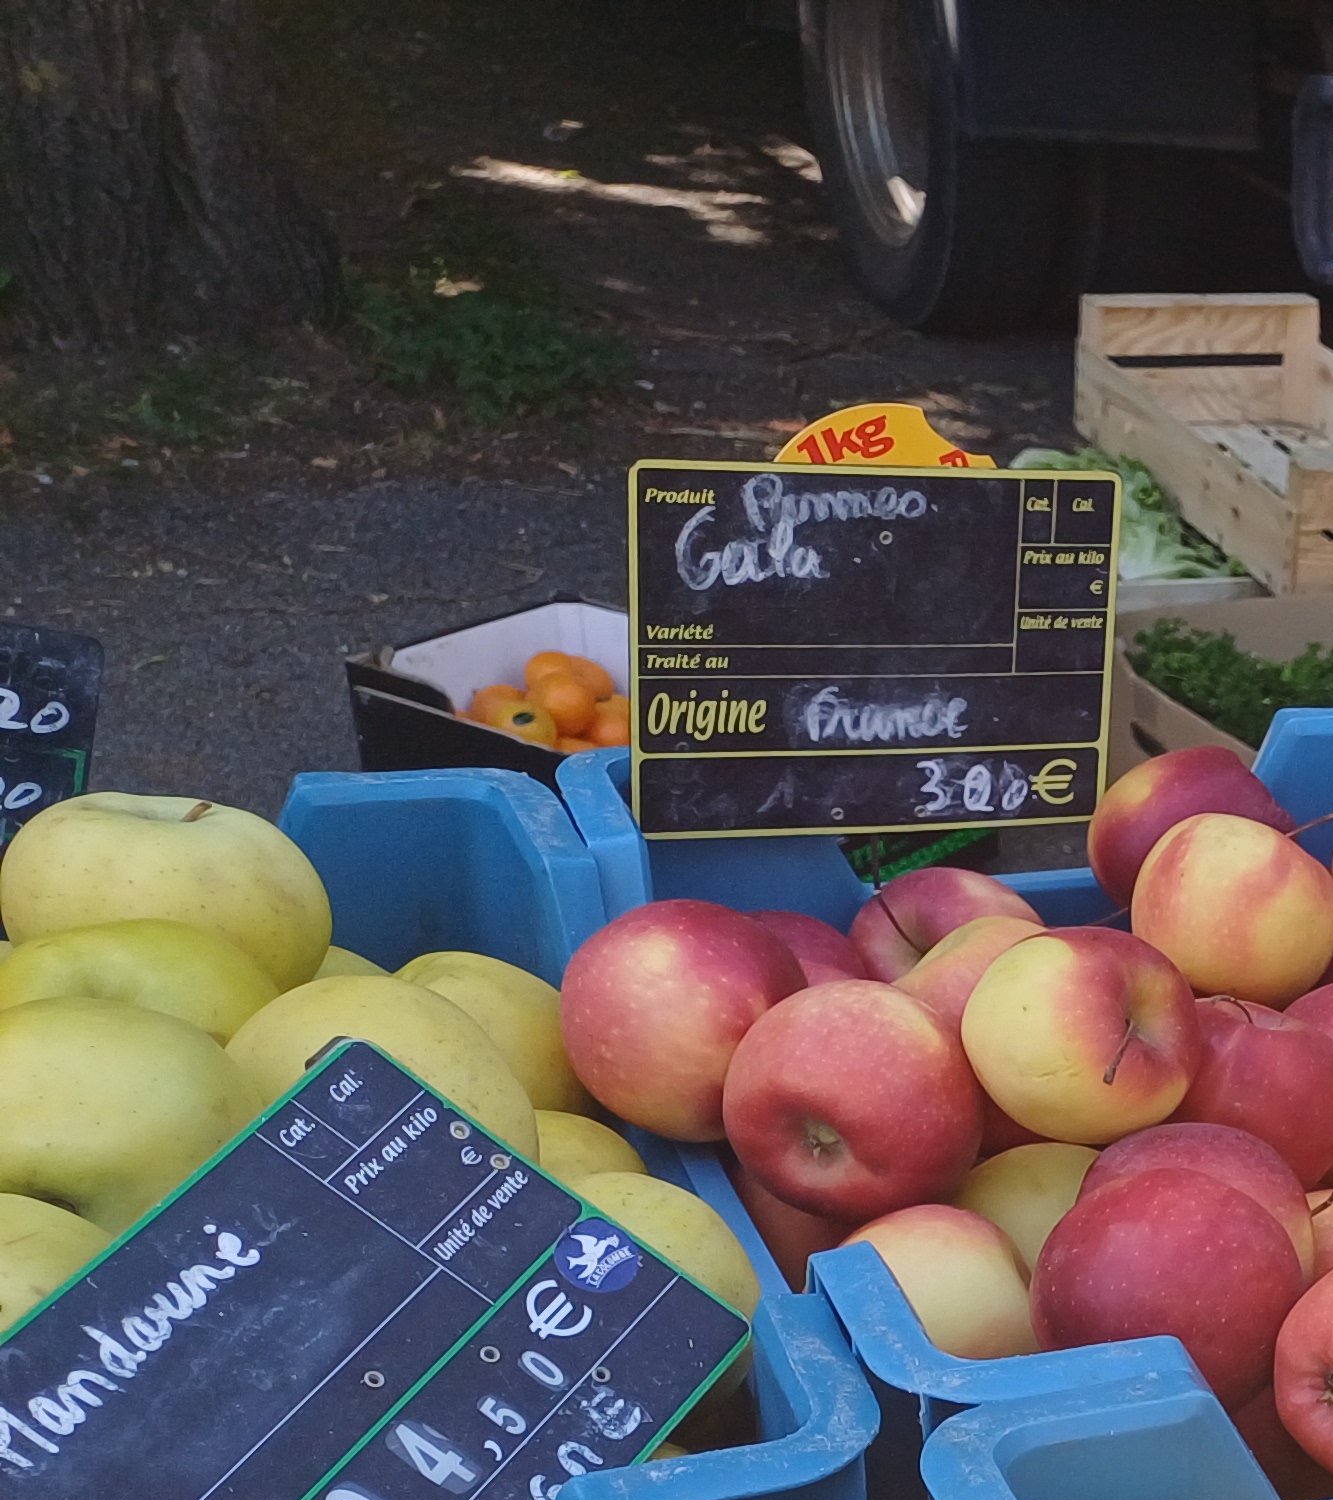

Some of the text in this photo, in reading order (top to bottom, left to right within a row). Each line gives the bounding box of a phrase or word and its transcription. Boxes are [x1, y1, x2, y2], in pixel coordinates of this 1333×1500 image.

[797, 415, 894, 464] 1kg
[644, 488, 717, 506] Produit
[676, 505, 831, 591] Gala
[1023, 550, 1104, 565] Prix au kilo
[1089, 580, 1104, 595] €
[646, 622, 713, 641] Variété
[1053, 615, 1069, 629] de
[646, 651, 729, 670] Traité au
[647, 690, 767, 741] Origine
[1031, 758, 1078, 806] €
[344, 1106, 438, 1195] Prix au kilo
[460, 1145, 483, 1166] €
[433, 1169, 529, 1261] Unité de vente
[525, 1279, 593, 1340] €
